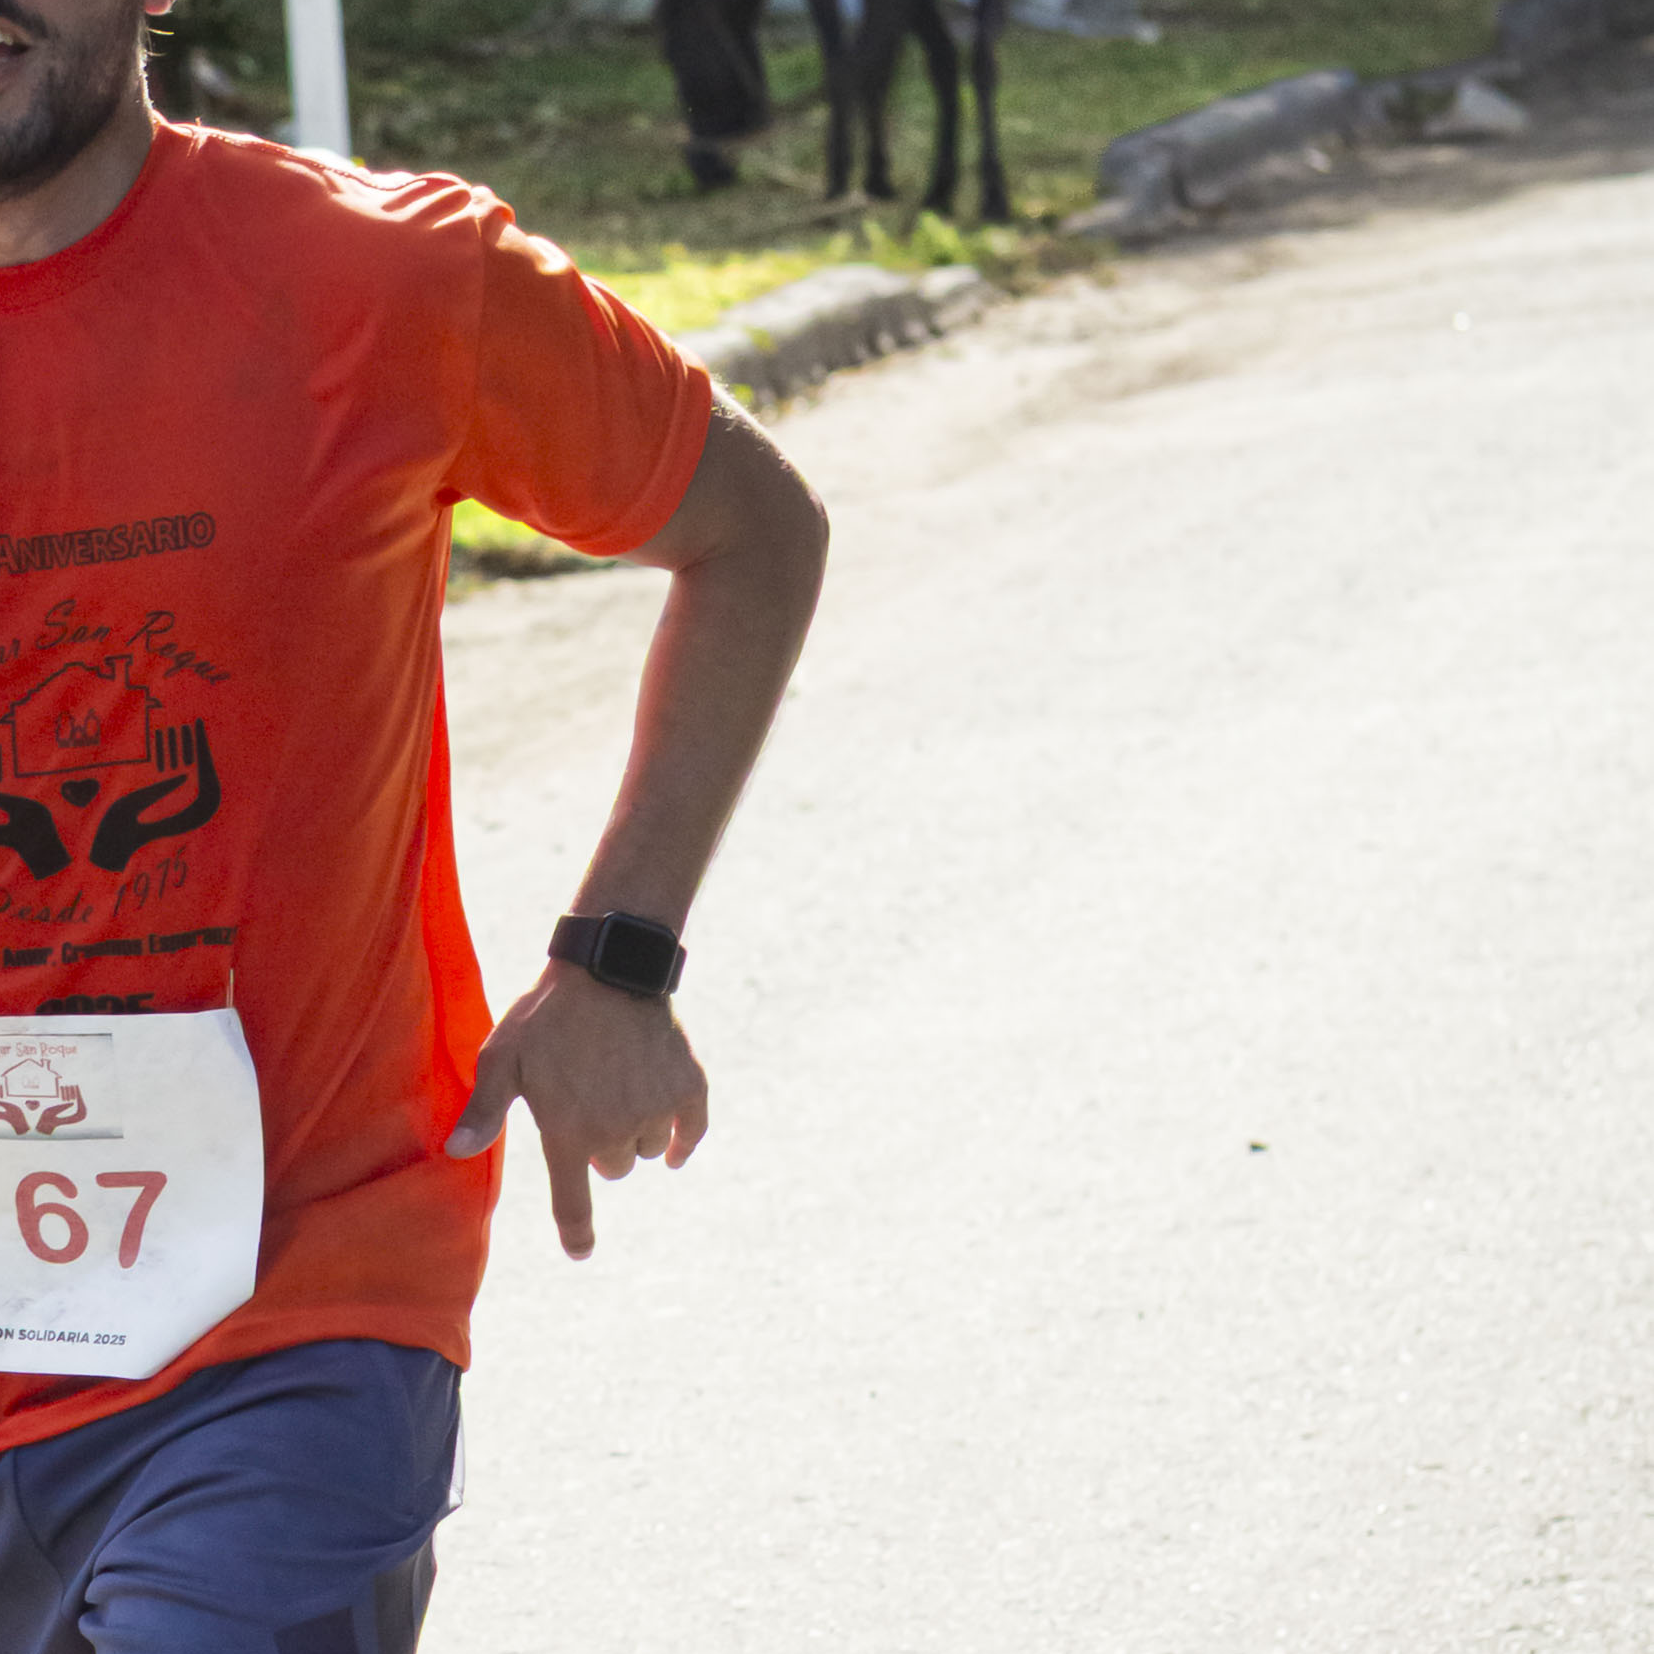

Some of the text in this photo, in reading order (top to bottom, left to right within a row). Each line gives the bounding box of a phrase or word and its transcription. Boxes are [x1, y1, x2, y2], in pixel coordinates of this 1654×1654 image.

[35, 599, 111, 650] San
[126, 610, 232, 686] Roque
[112, 845, 190, 918] 1975
[15, 1041, 38, 1058] San
[39, 1041, 78, 1058] Roque
[17, 1328, 90, 1344] SOLIDARIA
[92, 1332, 127, 1346] 2025
